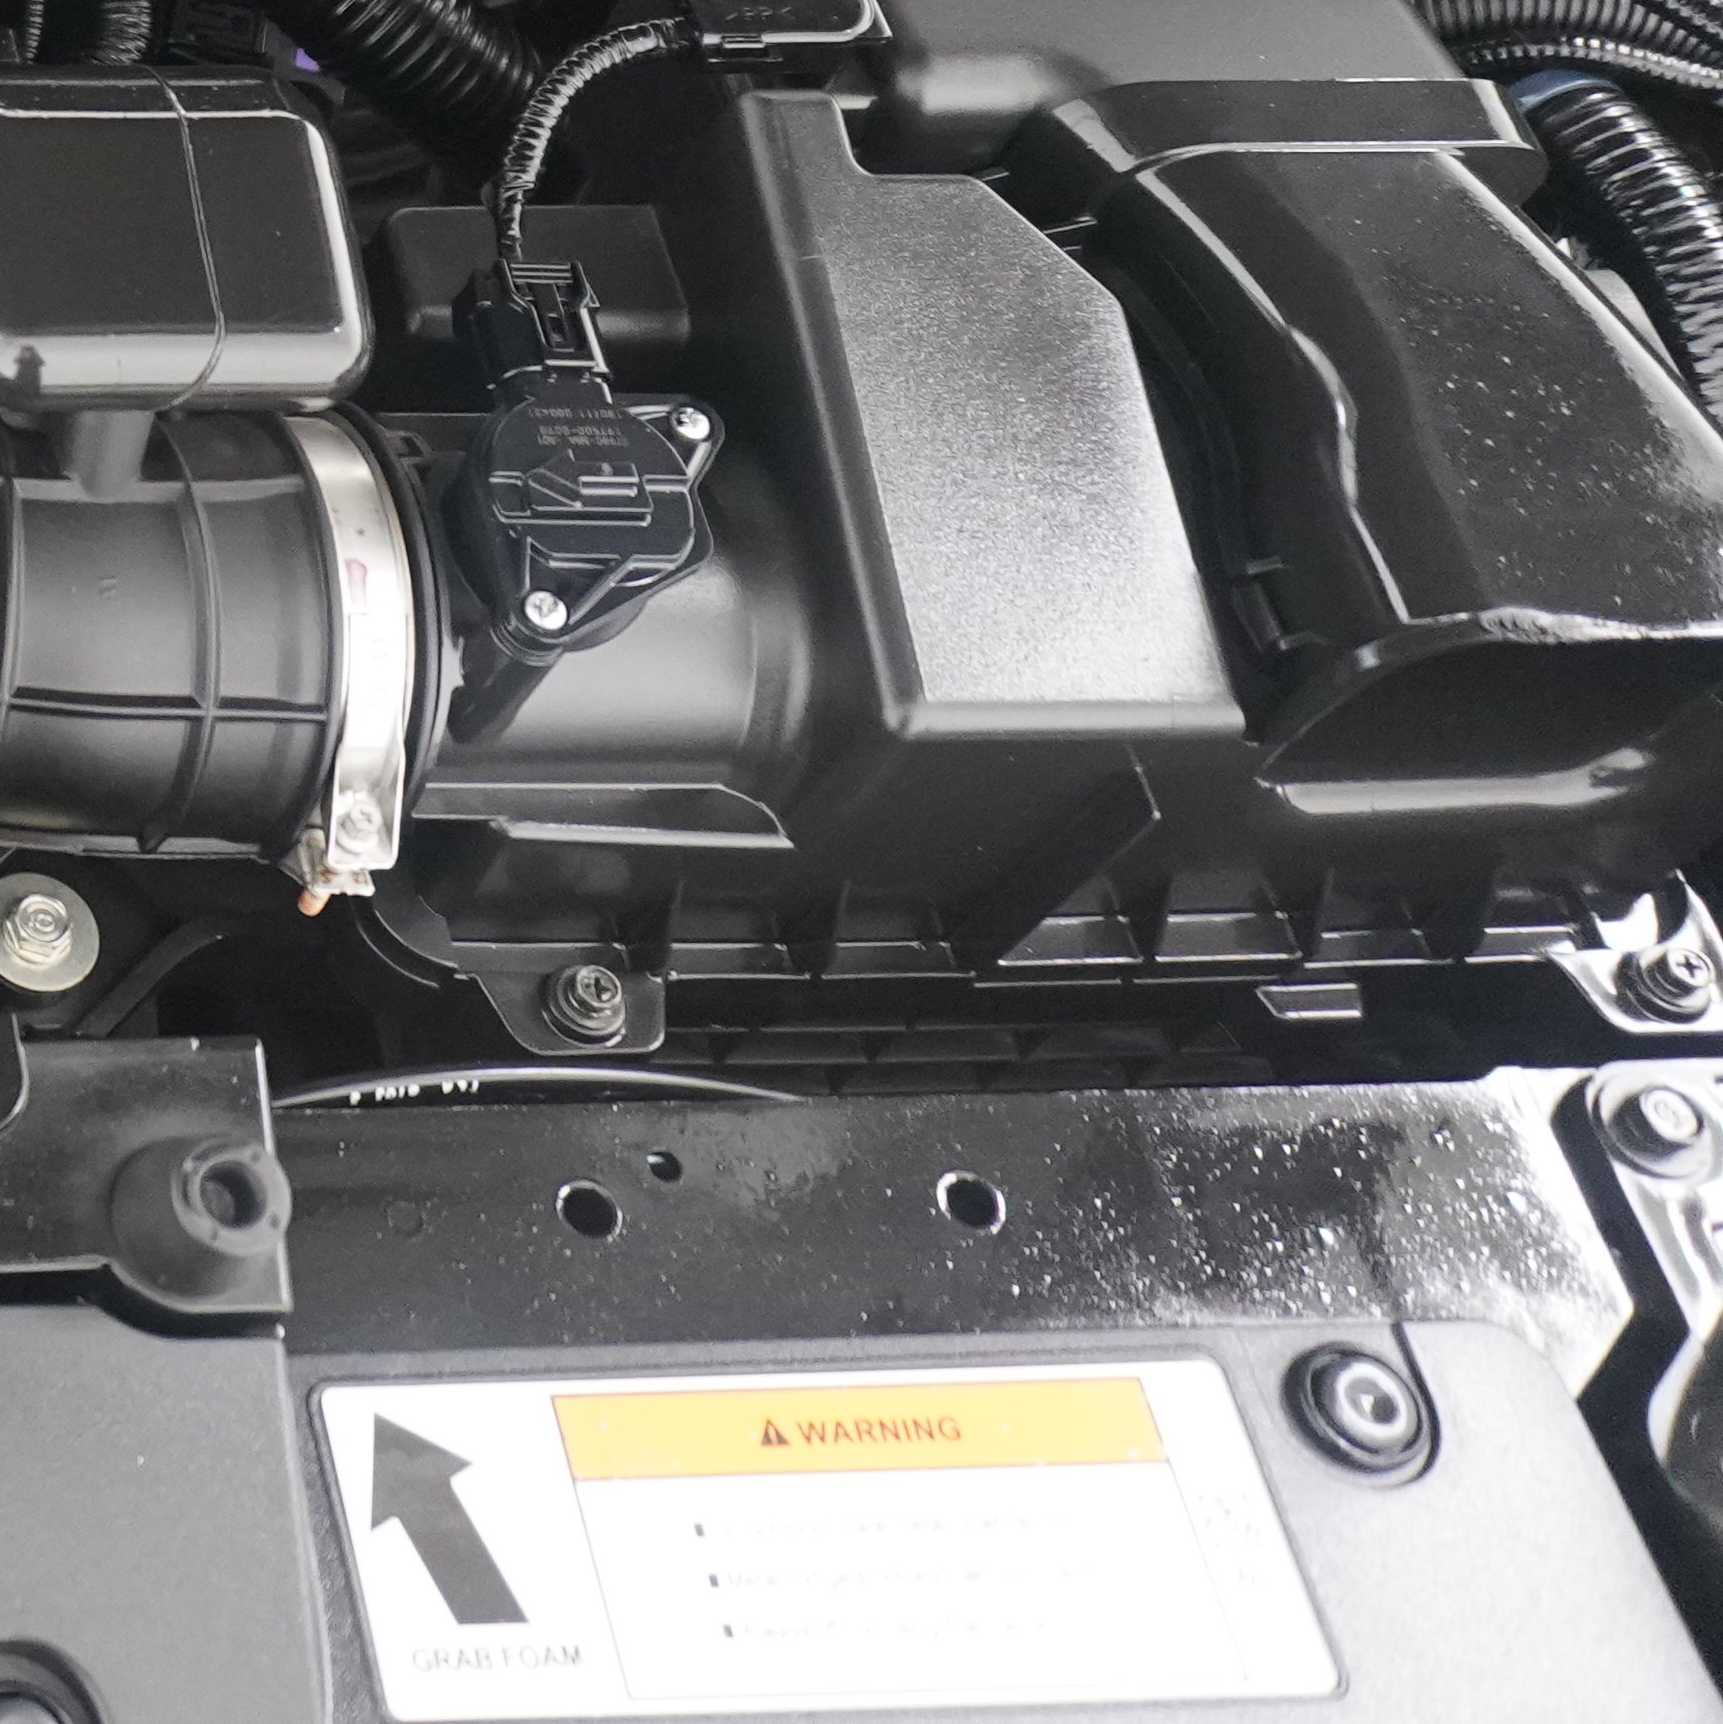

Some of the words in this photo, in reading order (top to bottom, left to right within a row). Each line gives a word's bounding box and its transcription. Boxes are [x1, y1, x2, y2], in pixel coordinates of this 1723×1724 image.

[798, 1415, 963, 1447] WARNING
[412, 1647, 493, 1672] GRAB
[501, 1644, 585, 1670] FOAM
